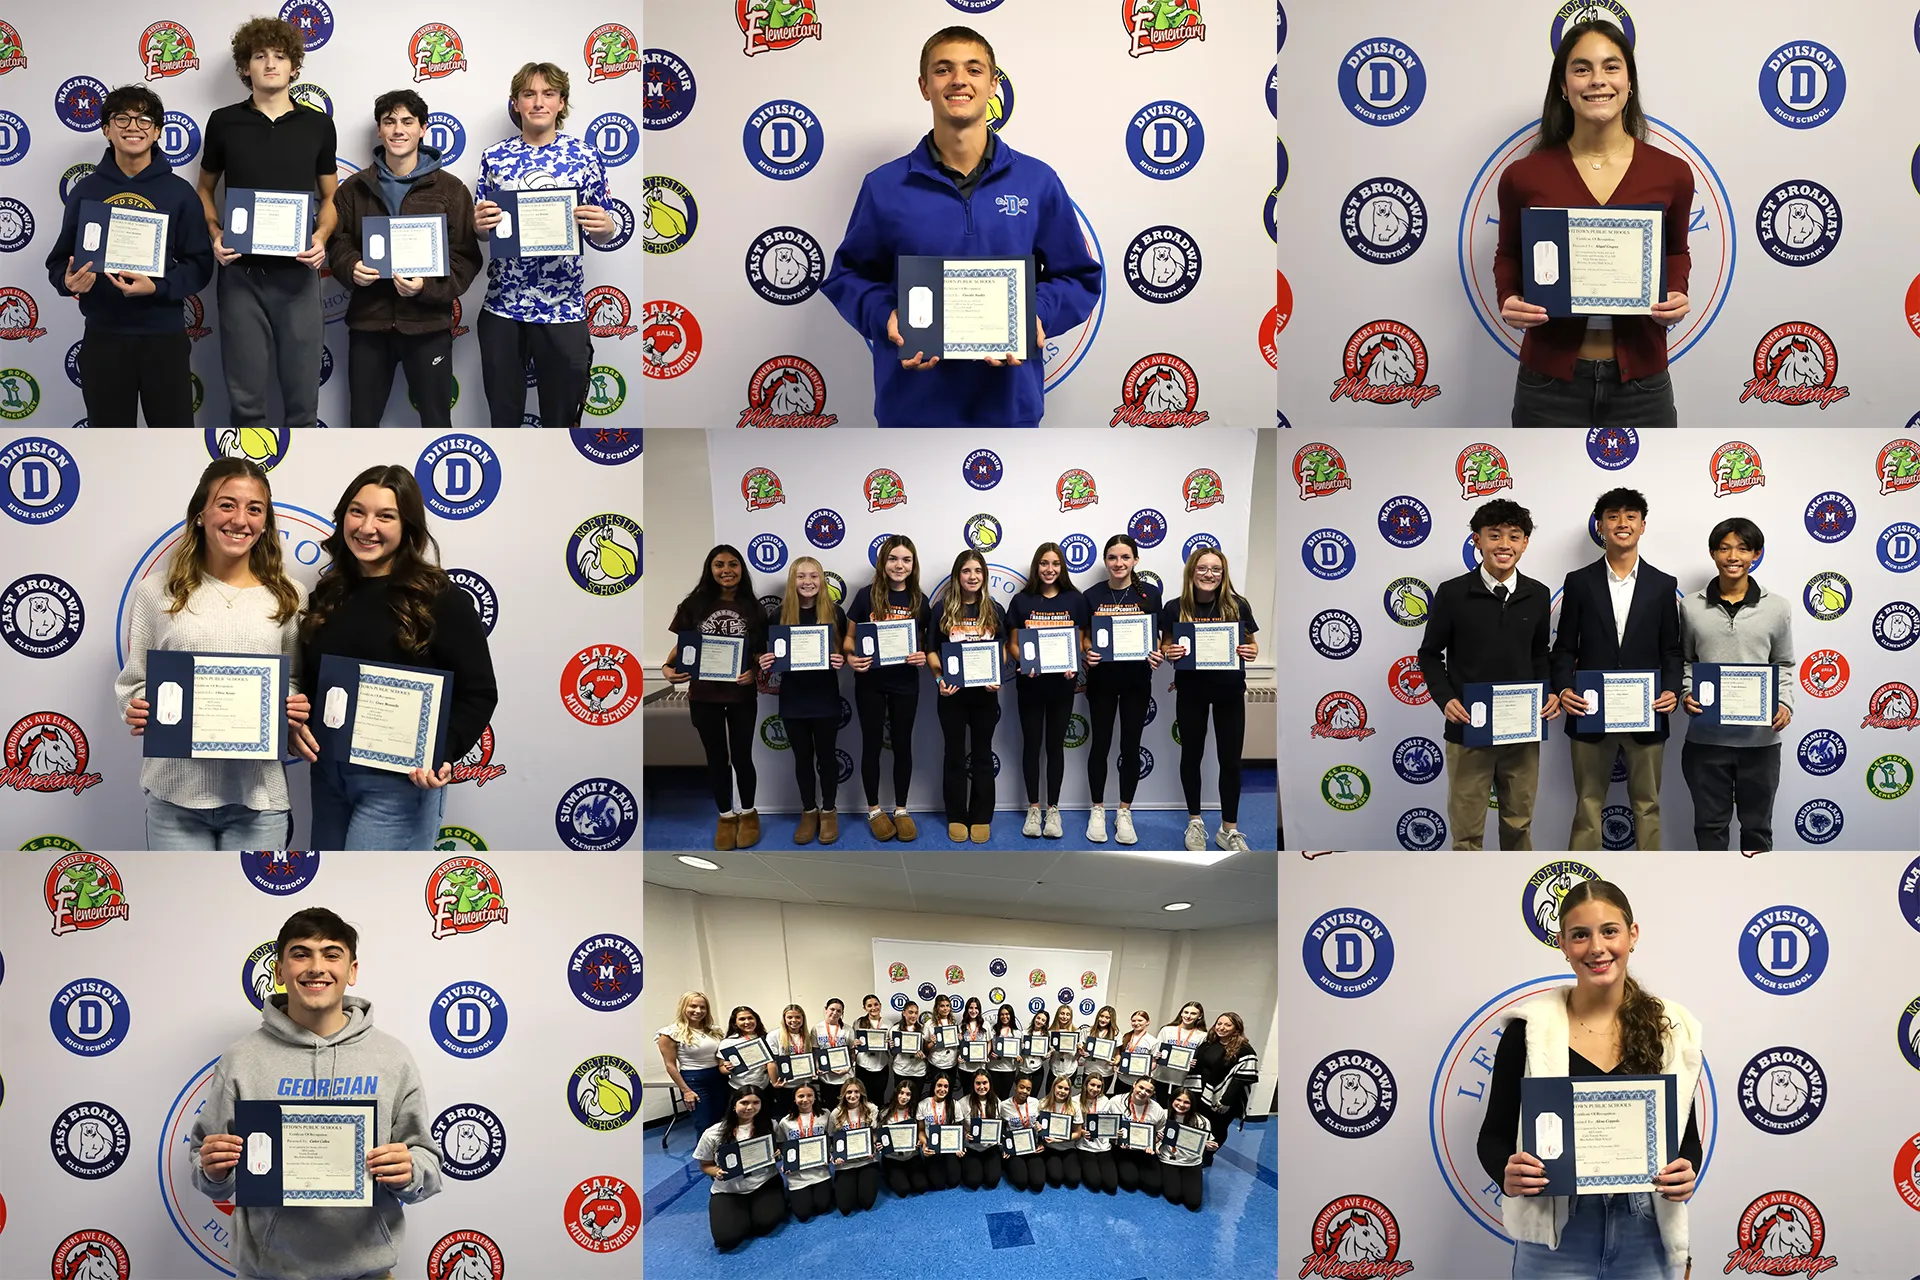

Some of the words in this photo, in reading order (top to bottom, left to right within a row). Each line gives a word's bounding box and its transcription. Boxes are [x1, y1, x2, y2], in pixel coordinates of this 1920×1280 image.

[147, 22, 169, 35] ABBEY
[170, 22, 188, 37] LANE
[416, 24, 438, 37] ABBEY
[439, 24, 456, 39] LANE
[742, 3, 822, 57] Elementary
[1129, 4, 1207, 58] Elementary
[144, 49, 199, 82] Elementary
[413, 51, 467, 84] Elementary
[1347, 43, 1417, 69] DIVISION
[1371, 62, 1395, 100] D
[752, 105, 815, 128] DIVISION
[1134, 106, 1196, 129] DIVISION
[1354, 103, 1375, 119] HIGH
[1377, 103, 1411, 120] SCHOOL
[590, 115, 634, 132] DIVISION
[605, 127, 620, 151] D
[773, 122, 795, 157] D
[1155, 123, 1176, 157] D
[758, 159, 777, 174] HIGH
[778, 160, 810, 175] SCHOOL
[1140, 160, 1159, 174] HIGH
[1160, 160, 1191, 175] SCHOOL
[1004, 195, 1020, 216] D
[1348, 199, 1360, 239] EAST
[1358, 183, 1422, 239] BROADWAY
[1763, 201, 1775, 241] EAST
[1773, 185, 1837, 241] BROADWAY
[752, 246, 763, 282] EAST
[761, 231, 819, 282] BROADWAY
[1130, 245, 1141, 281] EAST
[1139, 231, 1196, 281] BROADWAY
[1358, 244, 1412, 259] ELEMENTARY
[1773, 246, 1827, 261] ELEMENTARY
[761, 286, 811, 300] ELEMENTARY
[1139, 285, 1187, 299] ELEMENTARY
[1347, 325, 1373, 369] GARDINERS
[1375, 323, 1392, 332] AVE
[1393, 323, 1427, 369] ELEMENTARY
[1126, 358, 1149, 397] GARDINERS
[1151, 356, 1166, 364] AVE
[1167, 356, 1197, 397] ELEMENTARY
[1331, 374, 1442, 408] Mustangs
[424, 439, 492, 464] DIVISION
[965, 451, 1000, 470] MACARTHUR
[1717, 442, 1738, 455] ABBEY
[1739, 443, 1755, 457] LANE
[447, 458, 470, 495] D
[1714, 469, 1766, 498] Elementary
[430, 497, 451, 514] HIGH
[452, 498, 486, 514] SCHOOL
[1807, 495, 1853, 518] MACARTHUR
[576, 516, 642, 540] NORTHSIDE
[807, 511, 843, 529] MACARTHUR
[1826, 513, 1835, 522] M
[752, 536, 783, 548] DIVISION
[1307, 531, 1350, 547] DIVISION
[762, 545, 773, 562] D
[1321, 543, 1336, 565] D
[586, 583, 631, 596] SCHOOL
[6, 595, 19, 634] EAST
[16, 580, 78, 634] BROADWAY
[1313, 621, 1321, 645] EAST
[1320, 612, 1358, 645] BROADWAY
[16, 638, 69, 653] ELEMENTARY
[579, 647, 626, 665] SALK
[1319, 647, 1352, 656] ELEMENTARY
[1811, 651, 1840, 662] SALK
[564, 696, 600, 723] MIDDLE
[602, 696, 638, 723] SCHOOL
[8, 717, 34, 759] GARDINERS
[36, 715, 53, 724] AVE
[54, 715, 87, 759] ELEMENTARY
[1396, 739, 1424, 762] SUMMIT
[1428, 740, 1440, 761] LANE
[1324, 766, 1339, 781] LEE
[1341, 765, 1363, 776] ROAD
[1402, 771, 1433, 780] ELEMENTARY
[560, 782, 607, 821] SUMMIT
[613, 785, 633, 820] LANE
[1327, 793, 1368, 809] ELEMENTARY
[571, 837, 622, 849] ELEMENTARY
[55, 855, 87, 873] ABBEY
[88, 856, 113, 875] LANE
[436, 859, 466, 876] ABBEY
[468, 859, 492, 879] LANE
[51, 892, 129, 937] Elementary
[432, 896, 507, 941] Elementary
[1312, 913, 1384, 940] DIVISION
[572, 938, 641, 974] MACARTHUR
[1336, 933, 1361, 972] D
[600, 966, 614, 979] M
[1319, 975, 1341, 992] HIGH
[1342, 975, 1378, 992] SCHOOL
[58, 983, 121, 1006] DIVISION
[581, 991, 600, 1006] HIGH
[601, 992, 632, 1007] SCHOOL
[79, 1000, 101, 1034] D
[64, 1036, 83, 1051] HIGH
[85, 1036, 116, 1051] SCHOOL
[576, 1056, 640, 1079] NORTHSIDE
[278, 1076, 378, 1097] GEORGIAN
[1315, 1072, 1328, 1113] EAST
[1325, 1056, 1391, 1113] BROADWAY
[1745, 1069, 1758, 1109] EAST
[1756, 1053, 1821, 1109] BROADWAY
[57, 1122, 69, 1157] EAST
[66, 1107, 125, 1157] BROADWAY
[586, 1118, 629, 1130] SCHOOL
[1325, 1118, 1381, 1133] ELEMENTARY
[1755, 1114, 1811, 1129] ELEMENTARY
[66, 1162, 116, 1175] ELEMENTARY
[581, 1178, 626, 1196] SALK
[1315, 1201, 1342, 1246] GARDINERS
[1344, 1198, 1362, 1208] AVE
[1363, 1199, 1397, 1246] ELEMENTARY
[1742, 1196, 1768, 1241] GARDINERS
[1770, 1194, 1787, 1203] AVE
[1789, 1195, 1822, 1241] ELEMENTARY
[568, 1224, 601, 1250] MIDDLE
[604, 1224, 637, 1250] SCHOOL
[1726, 1246, 1837, 1280] Mustangs
